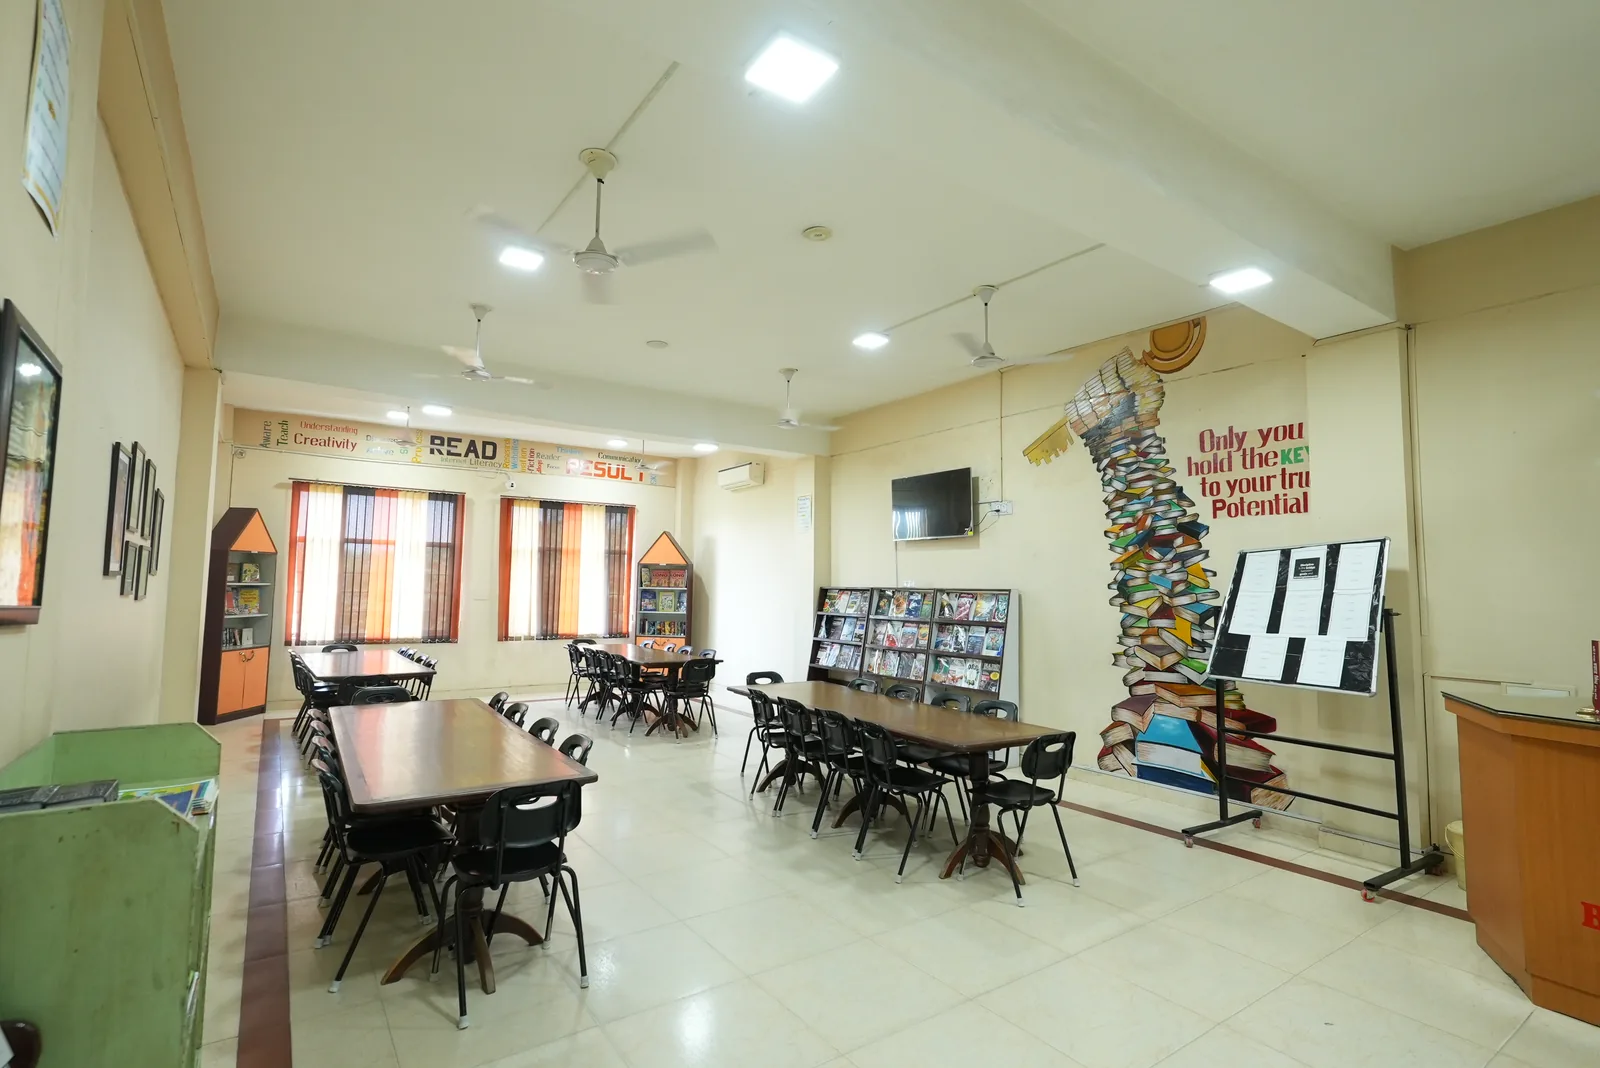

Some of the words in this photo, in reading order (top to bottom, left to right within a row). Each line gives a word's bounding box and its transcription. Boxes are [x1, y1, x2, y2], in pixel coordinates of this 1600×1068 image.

[259, 420, 272, 448] Aware
[277, 420, 288, 446] Teach
[300, 421, 358, 436] Understanding
[1199, 426, 1247, 453] Only
[1257, 422, 1304, 448] you
[294, 433, 357, 451] Creativity
[430, 435, 497, 460] READ
[469, 458, 502, 469] Literacy
[536, 452, 561, 461] Reader
[1187, 451, 1233, 477] hold
[1240, 447, 1278, 470] the
[1200, 477, 1221, 498] to
[1226, 475, 1277, 498] your
[1212, 492, 1309, 519] Potential
